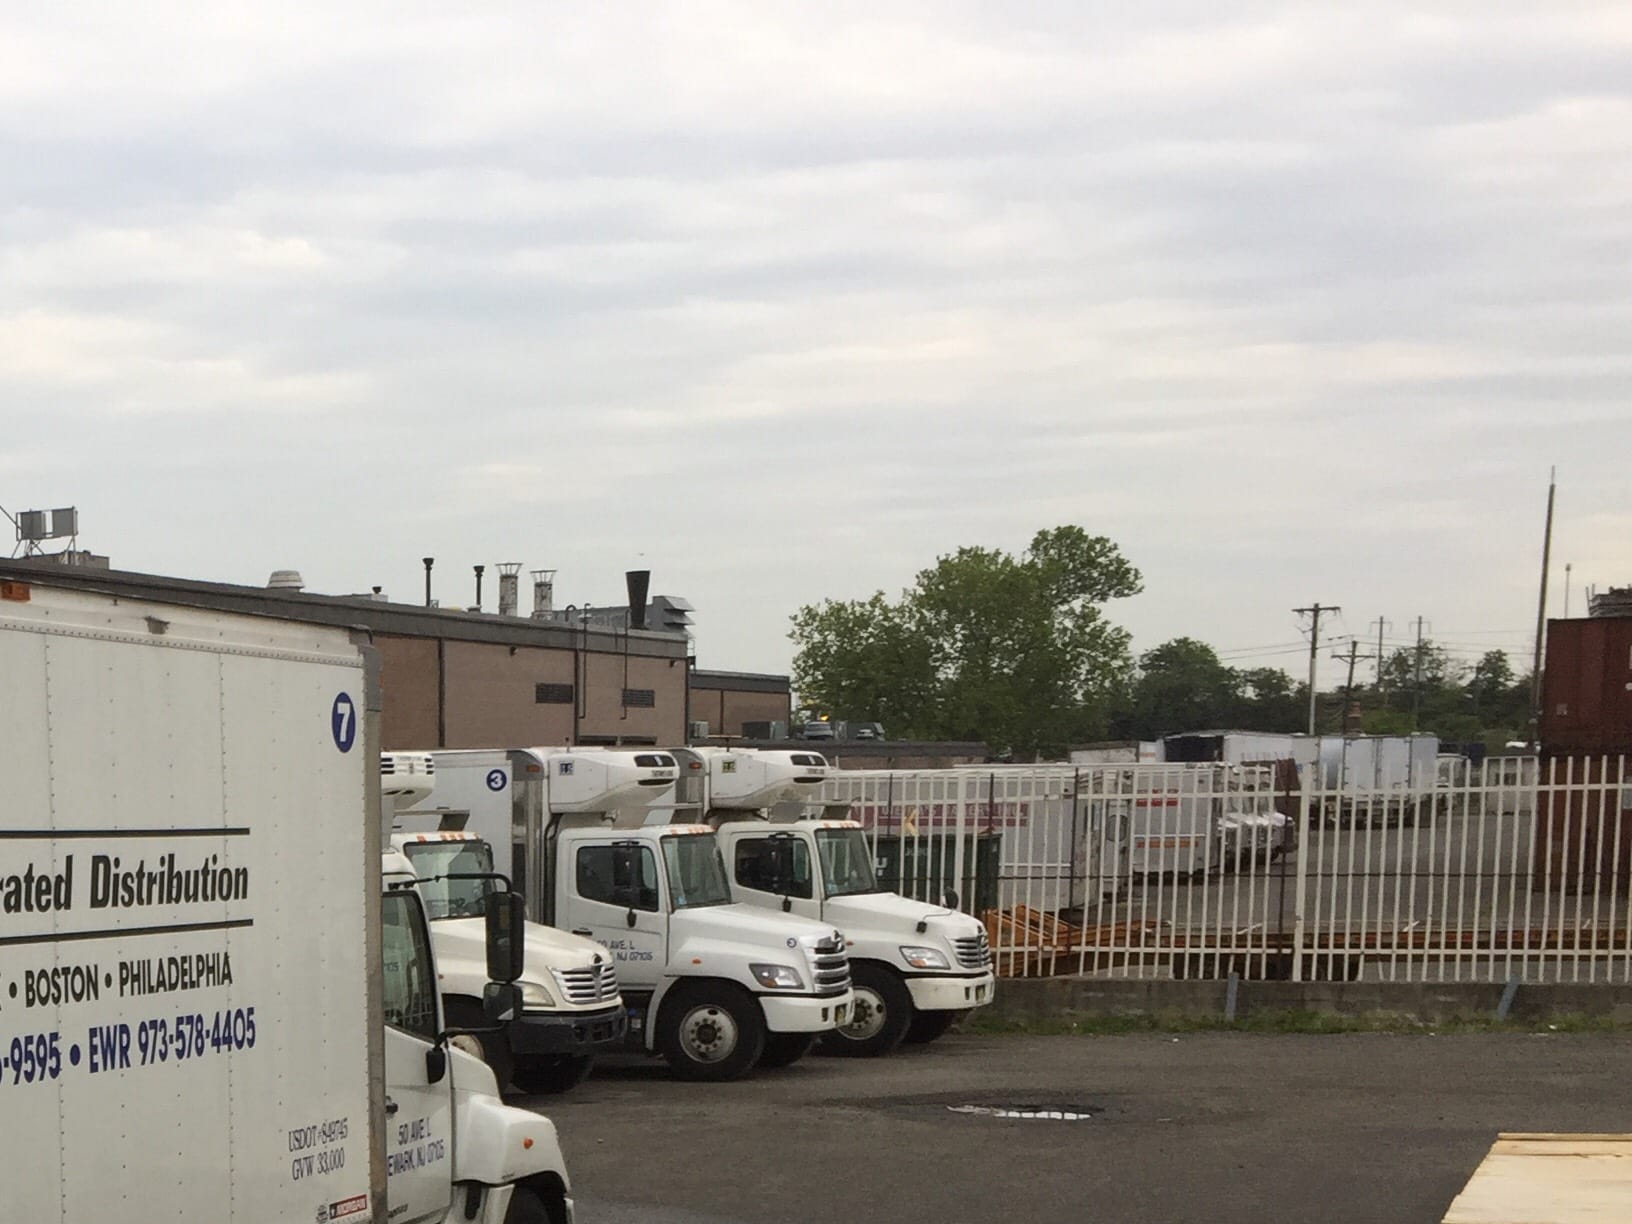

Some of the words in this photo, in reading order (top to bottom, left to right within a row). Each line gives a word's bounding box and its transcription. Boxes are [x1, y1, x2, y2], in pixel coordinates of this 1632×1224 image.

[336, 702, 351, 742] 7
[490, 771, 504, 789] 3
[89, 853, 249, 909] Distribution
[24, 963, 100, 1008] BOSTON
[119, 951, 233, 998] PHILADELPHIA
[88, 1023, 132, 1073] EWR
[138, 1006, 257, 1067] 973-578-4405
[398, 1124, 408, 1146] 50
[292, 1155, 316, 1181] GVW
[317, 1147, 346, 1175] 33,000
[417, 1145, 426, 1167] NJ
